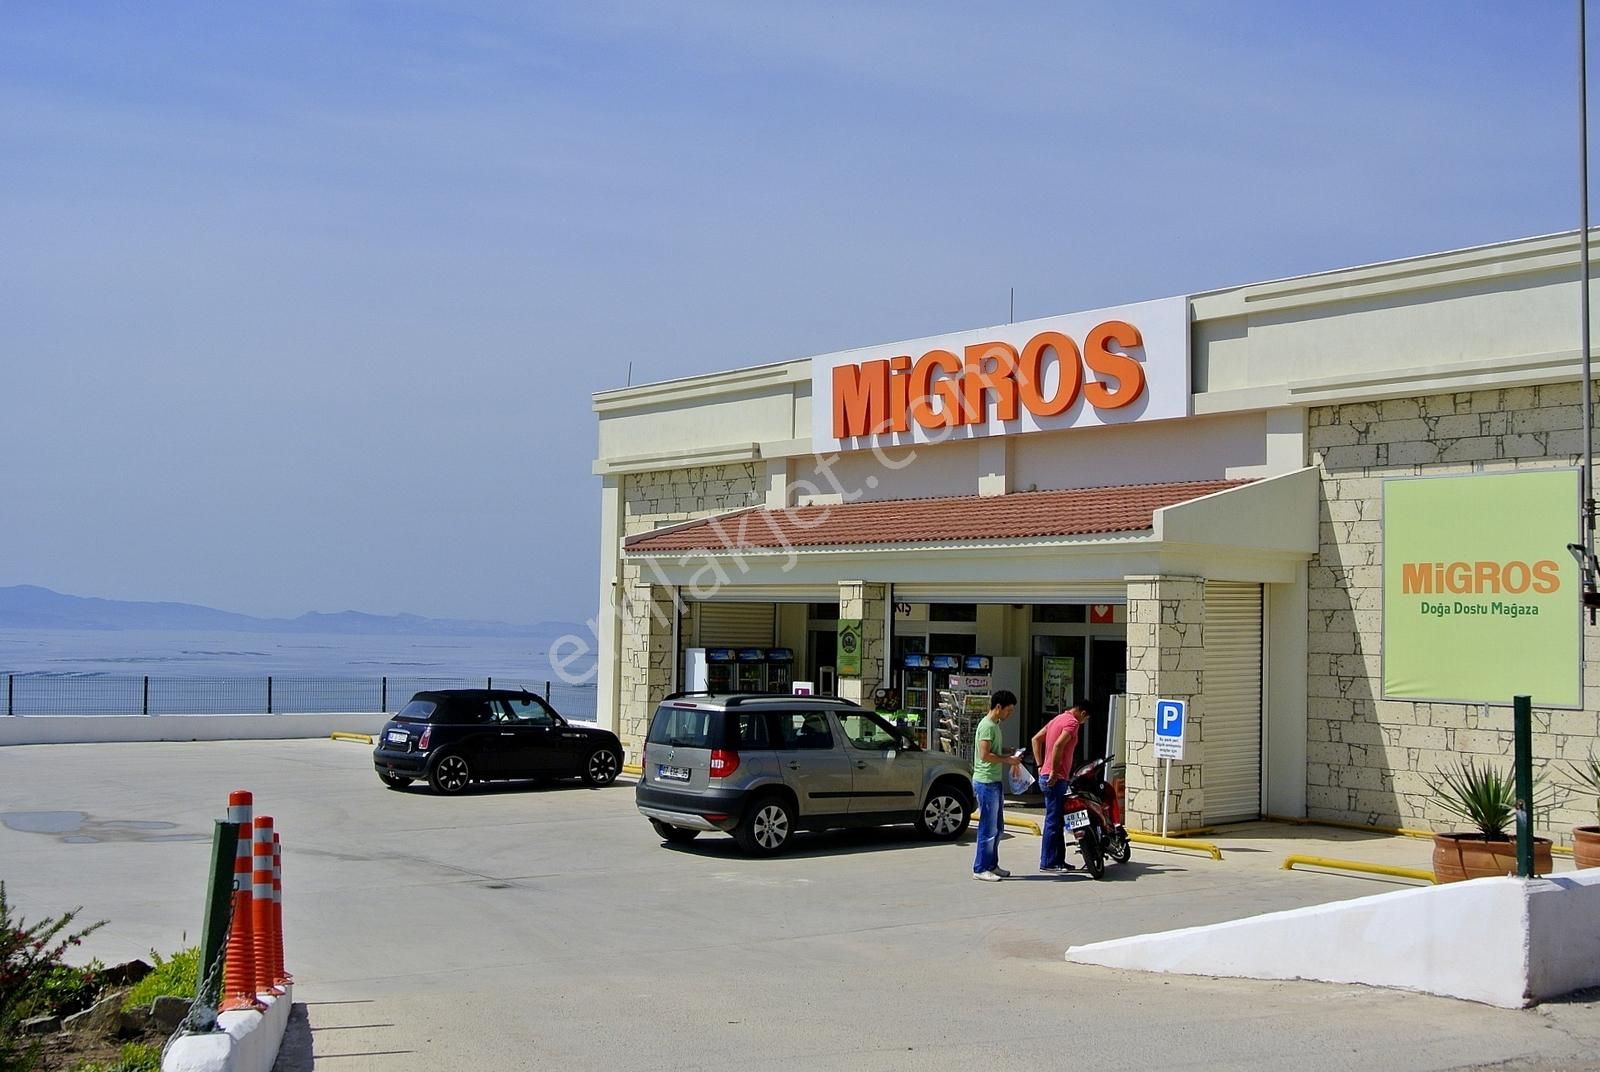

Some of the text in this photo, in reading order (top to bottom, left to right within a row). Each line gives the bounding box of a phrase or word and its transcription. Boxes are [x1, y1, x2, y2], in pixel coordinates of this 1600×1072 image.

[832, 319, 1148, 440] MiGROS
[1402, 560, 1560, 595] MiGROS
[1421, 602, 1539, 618] Doğa Dostu Mağaza
[1163, 706, 1178, 729] P
